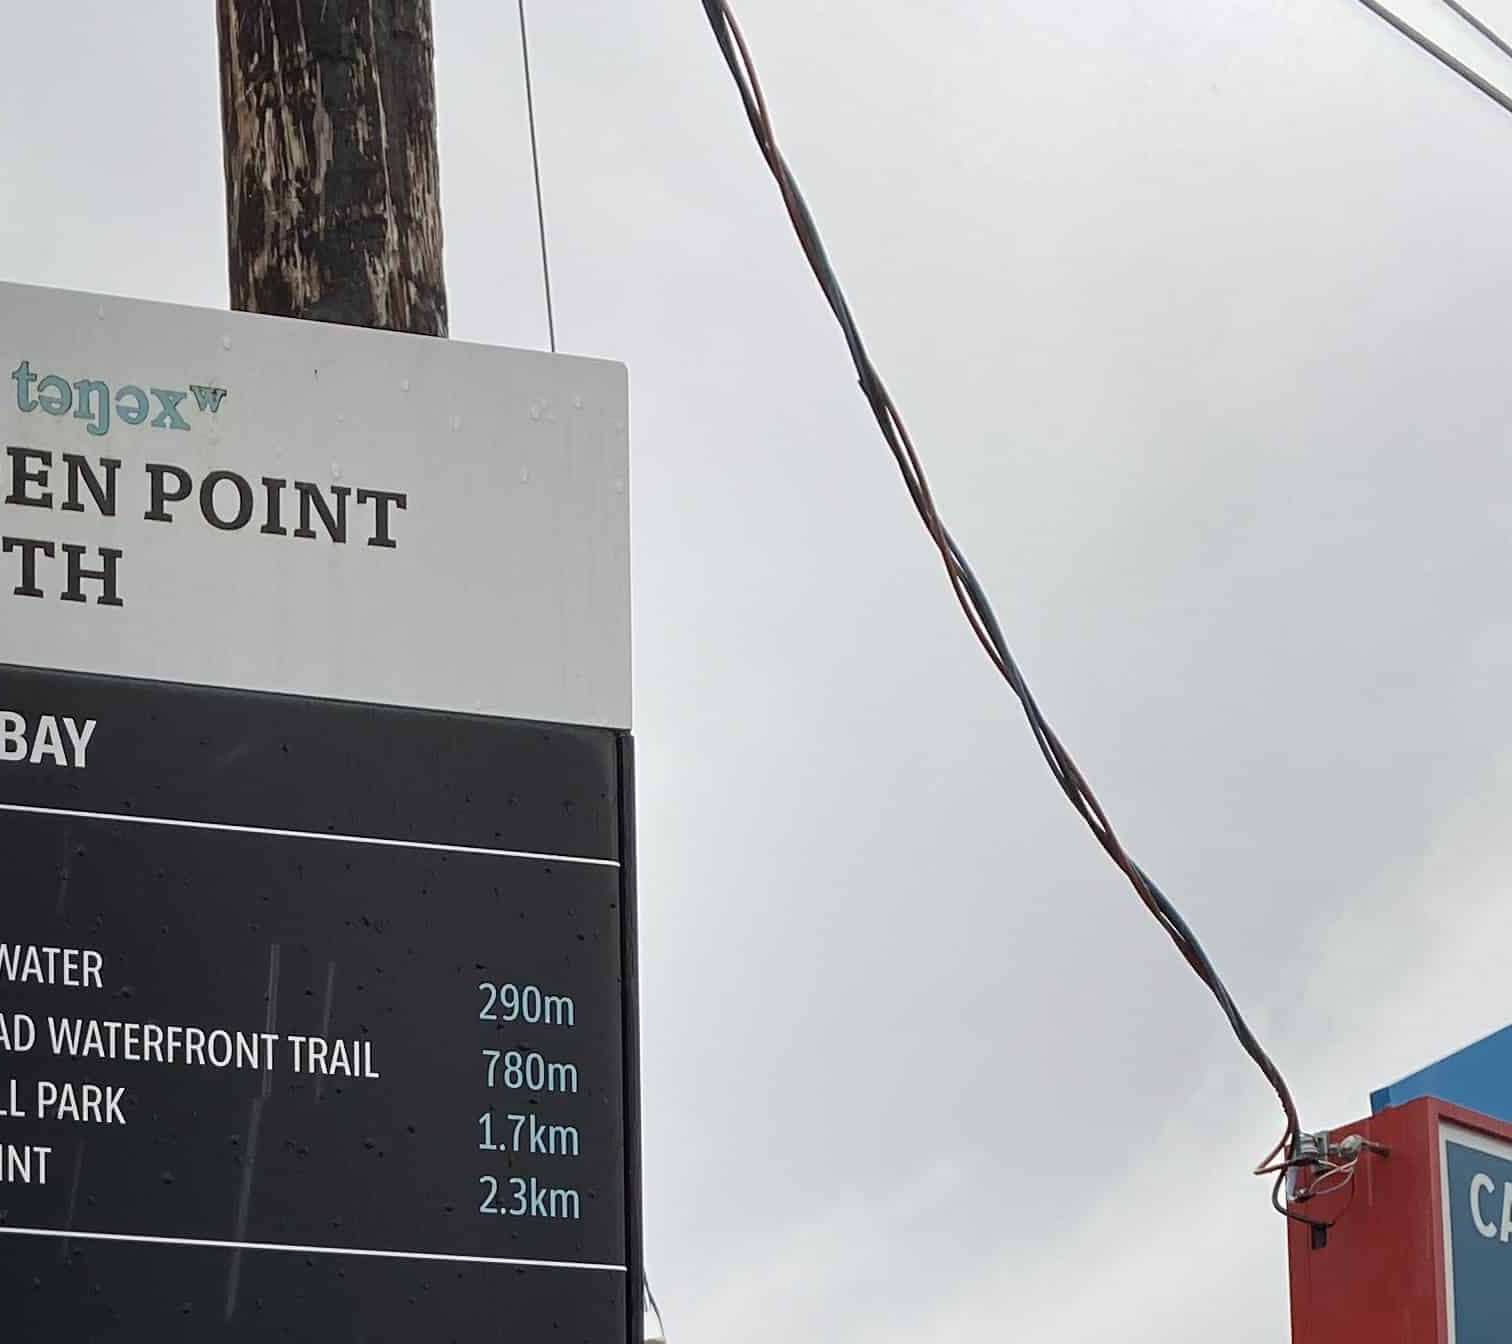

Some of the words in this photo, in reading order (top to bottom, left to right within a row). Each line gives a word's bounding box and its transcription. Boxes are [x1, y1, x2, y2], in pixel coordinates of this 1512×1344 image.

[144, 463, 408, 548] POINT
[479, 983, 575, 1026] 290m
[47, 1016, 278, 1072] WATERFRONT
[287, 1035, 379, 1079] TRAIL
[483, 1050, 578, 1094] 780m
[37, 1080, 127, 1125] PARK
[479, 1113, 580, 1156] 1.7km
[479, 1176, 580, 1220] 2.3km
